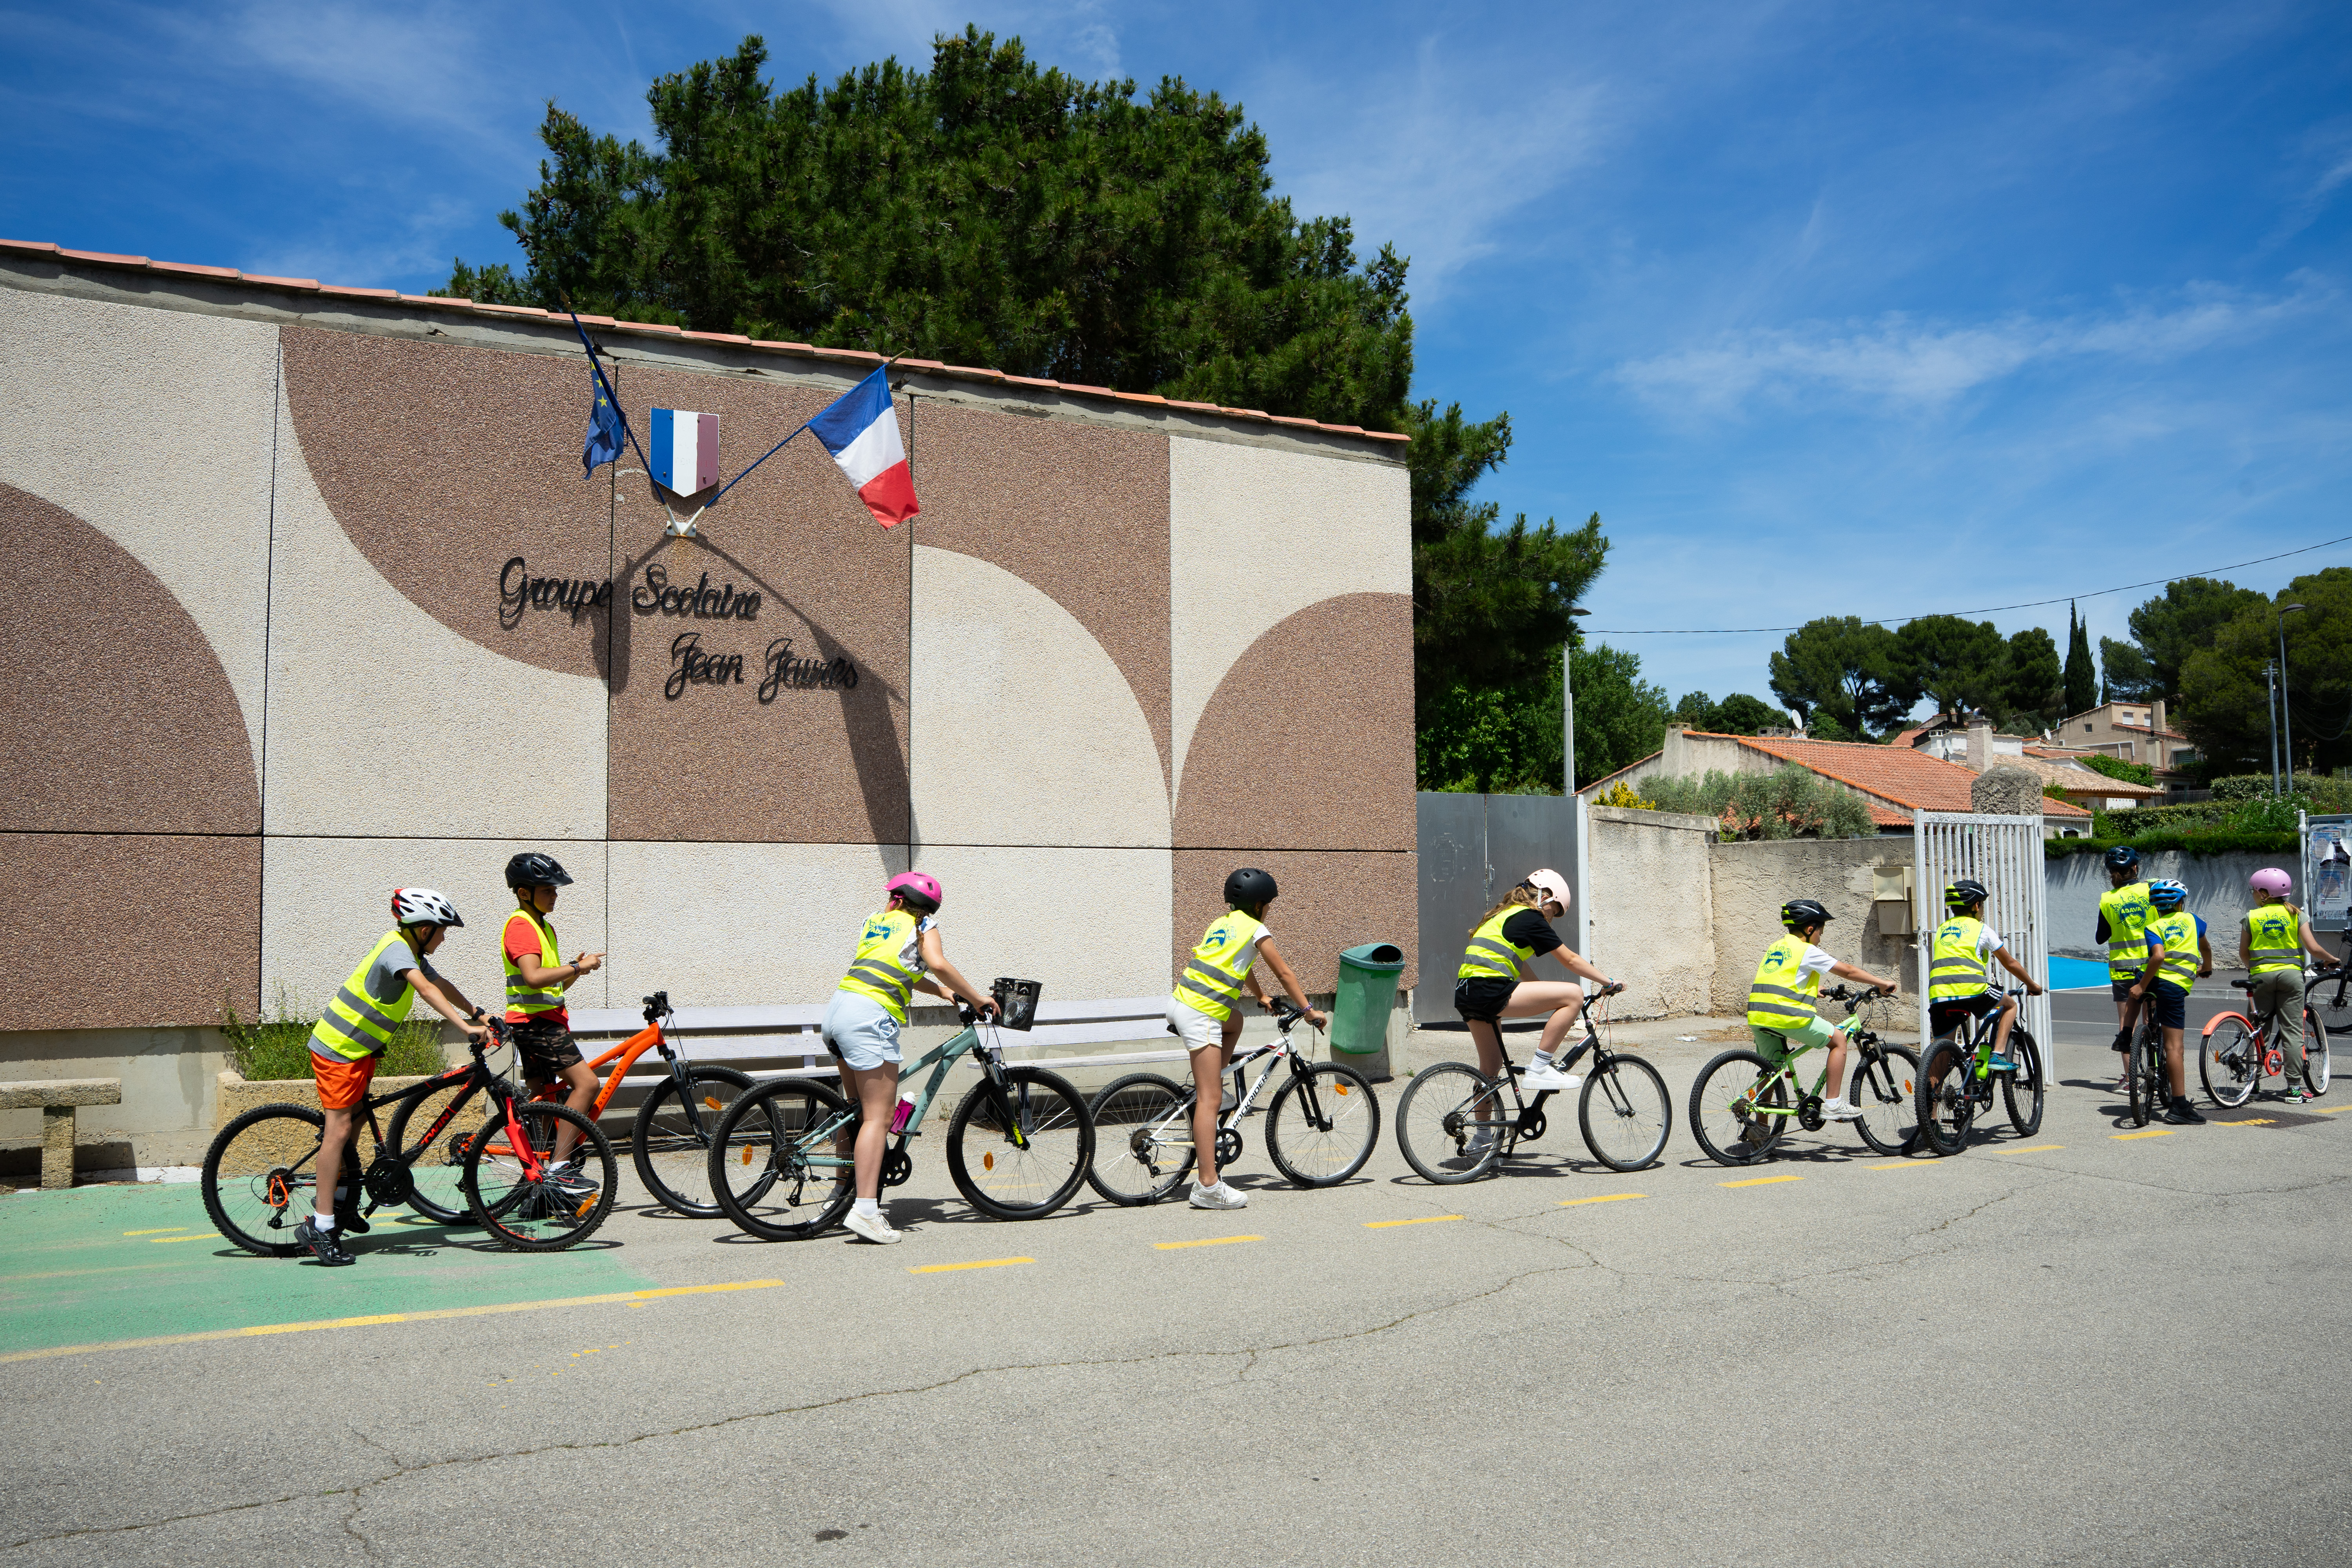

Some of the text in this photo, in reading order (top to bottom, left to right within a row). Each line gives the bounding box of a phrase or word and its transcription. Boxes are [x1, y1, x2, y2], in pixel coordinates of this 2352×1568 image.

[499, 557, 761, 618] Groupe Scolaire
[665, 632, 744, 697] Jean
[414, 900, 436, 916] ROCKRIDER
[596, 1068, 622, 1110] ROCKRIDER
[921, 1068, 945, 1113] ROCKRIDER
[1232, 1074, 1268, 1129] ROCKRIDER
